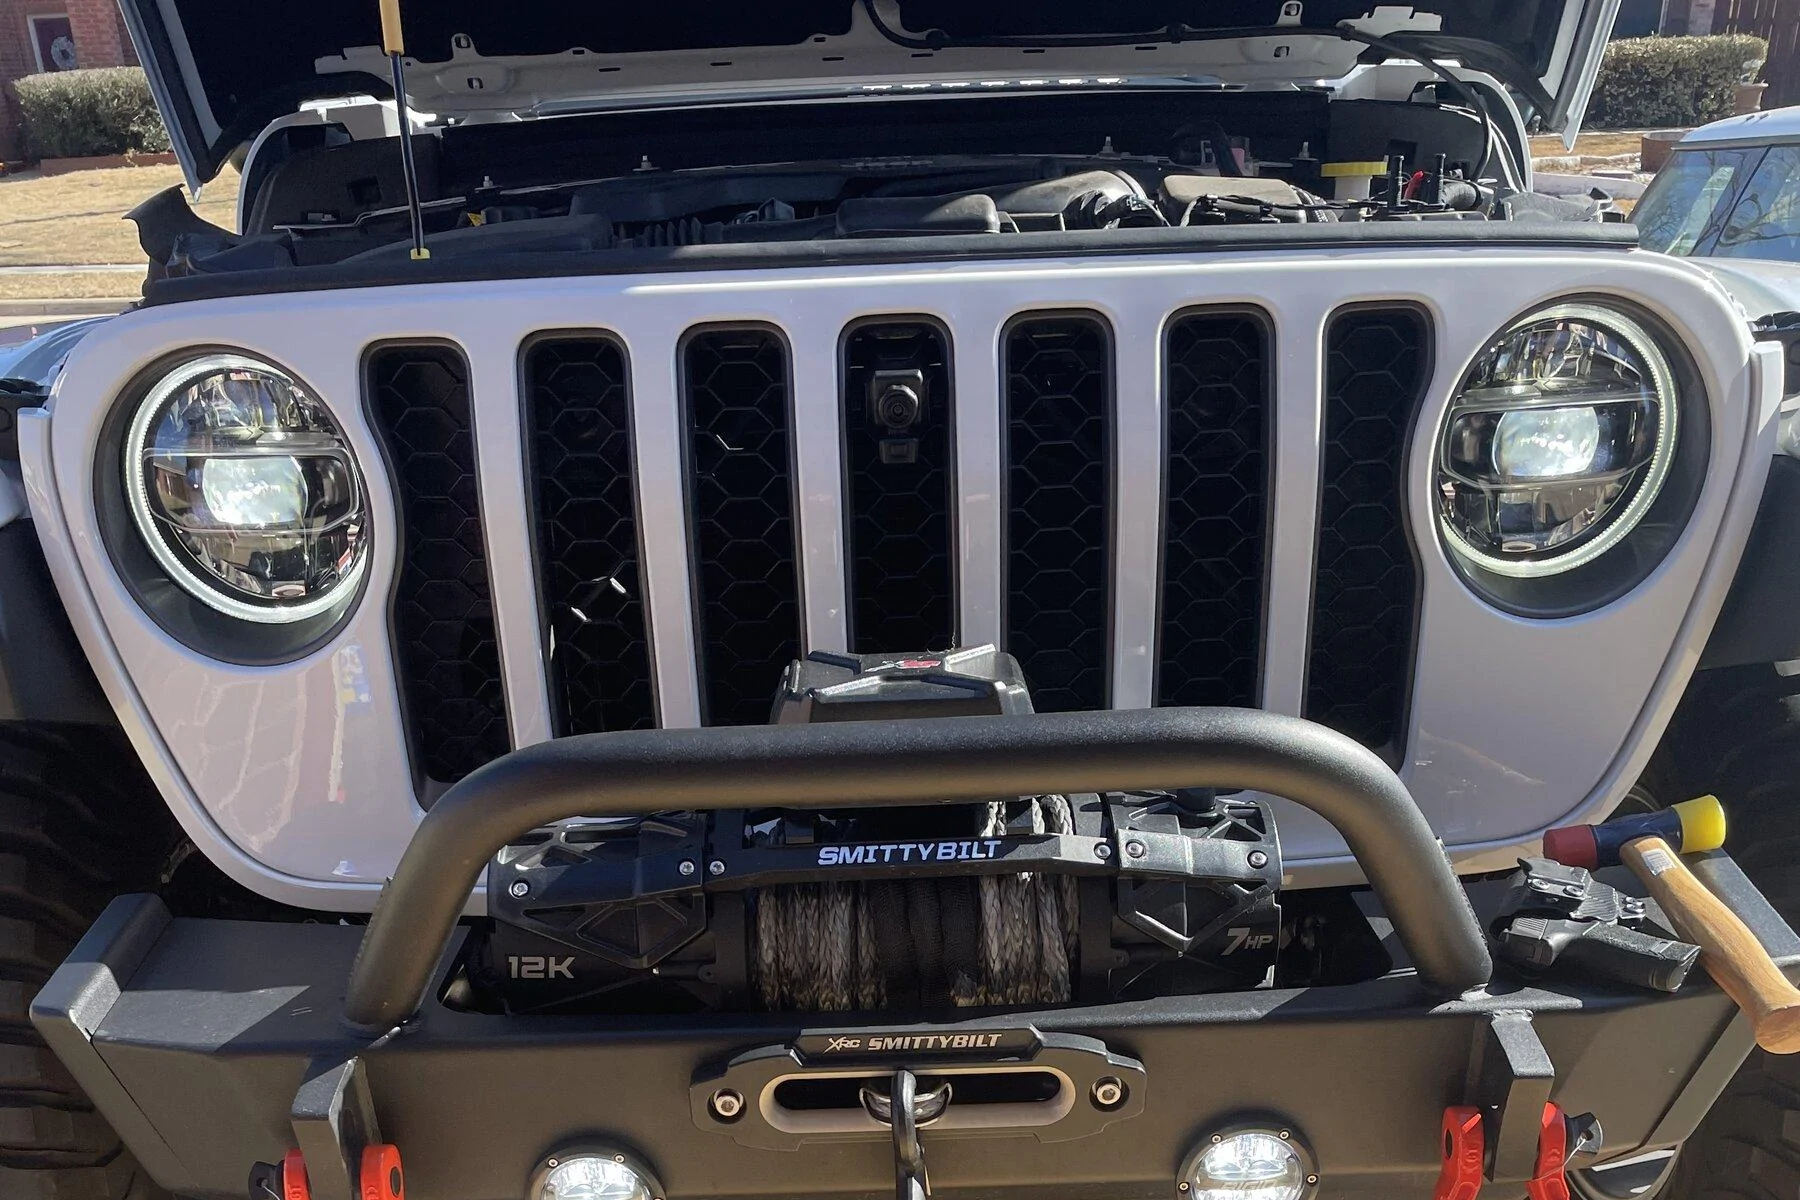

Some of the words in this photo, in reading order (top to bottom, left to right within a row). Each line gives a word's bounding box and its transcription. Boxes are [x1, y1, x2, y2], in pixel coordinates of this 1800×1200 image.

[818, 840, 1002, 866] SMITTYBILT
[1221, 927, 1274, 956] 7HP
[508, 956, 576, 979] 12K
[868, 1034, 1002, 1051] SMITTYBILT
